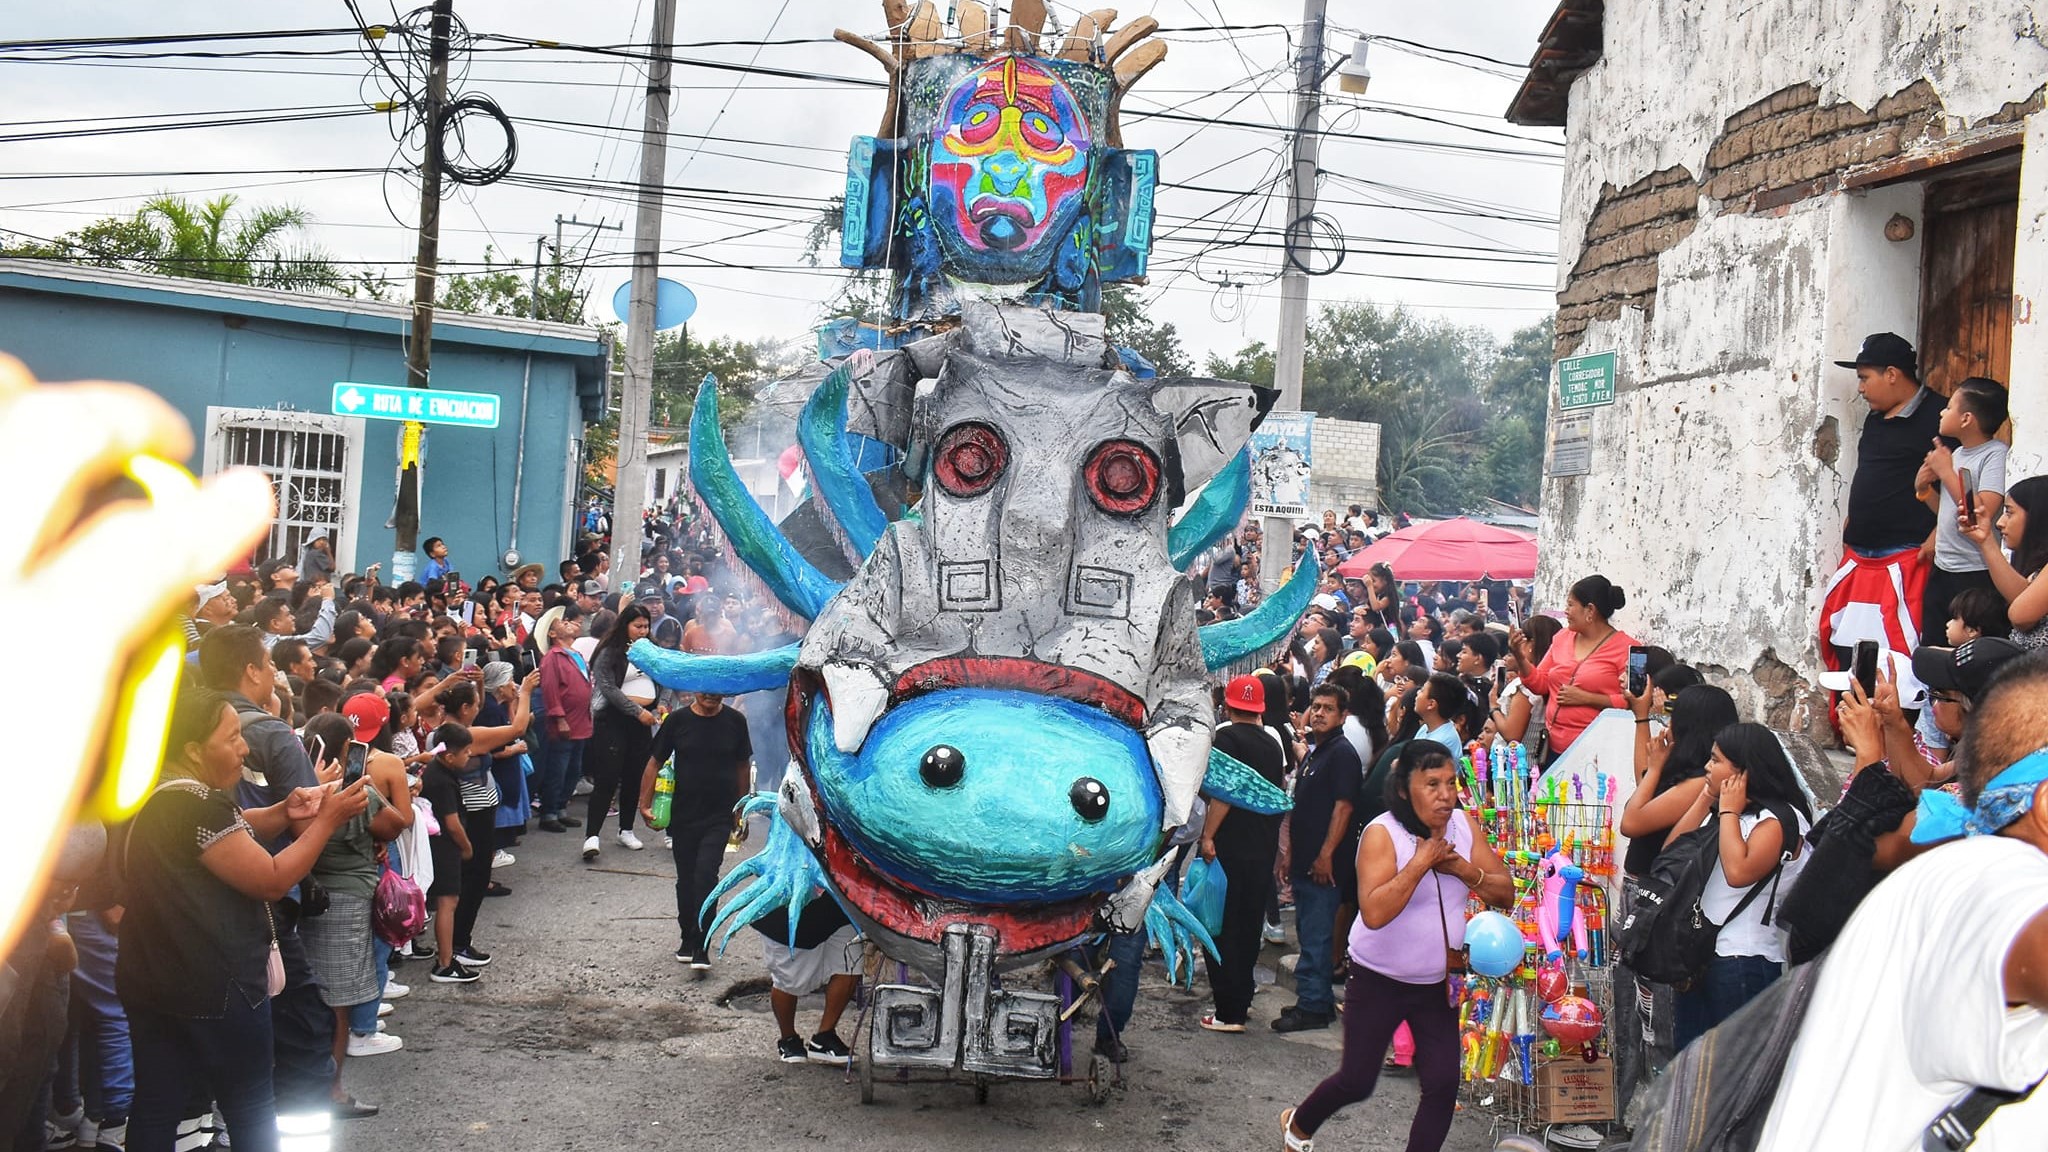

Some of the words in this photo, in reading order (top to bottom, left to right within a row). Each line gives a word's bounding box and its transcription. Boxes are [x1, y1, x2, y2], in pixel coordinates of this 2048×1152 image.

[1562, 360, 1581, 371] CALLE
[1568, 367, 1605, 382] CORREGIDORA
[374, 394, 402, 412] RUTA
[408, 396, 424, 415] DE
[429, 398, 494, 420] EVACUACION
[1254, 504, 1274, 513] ESTA
